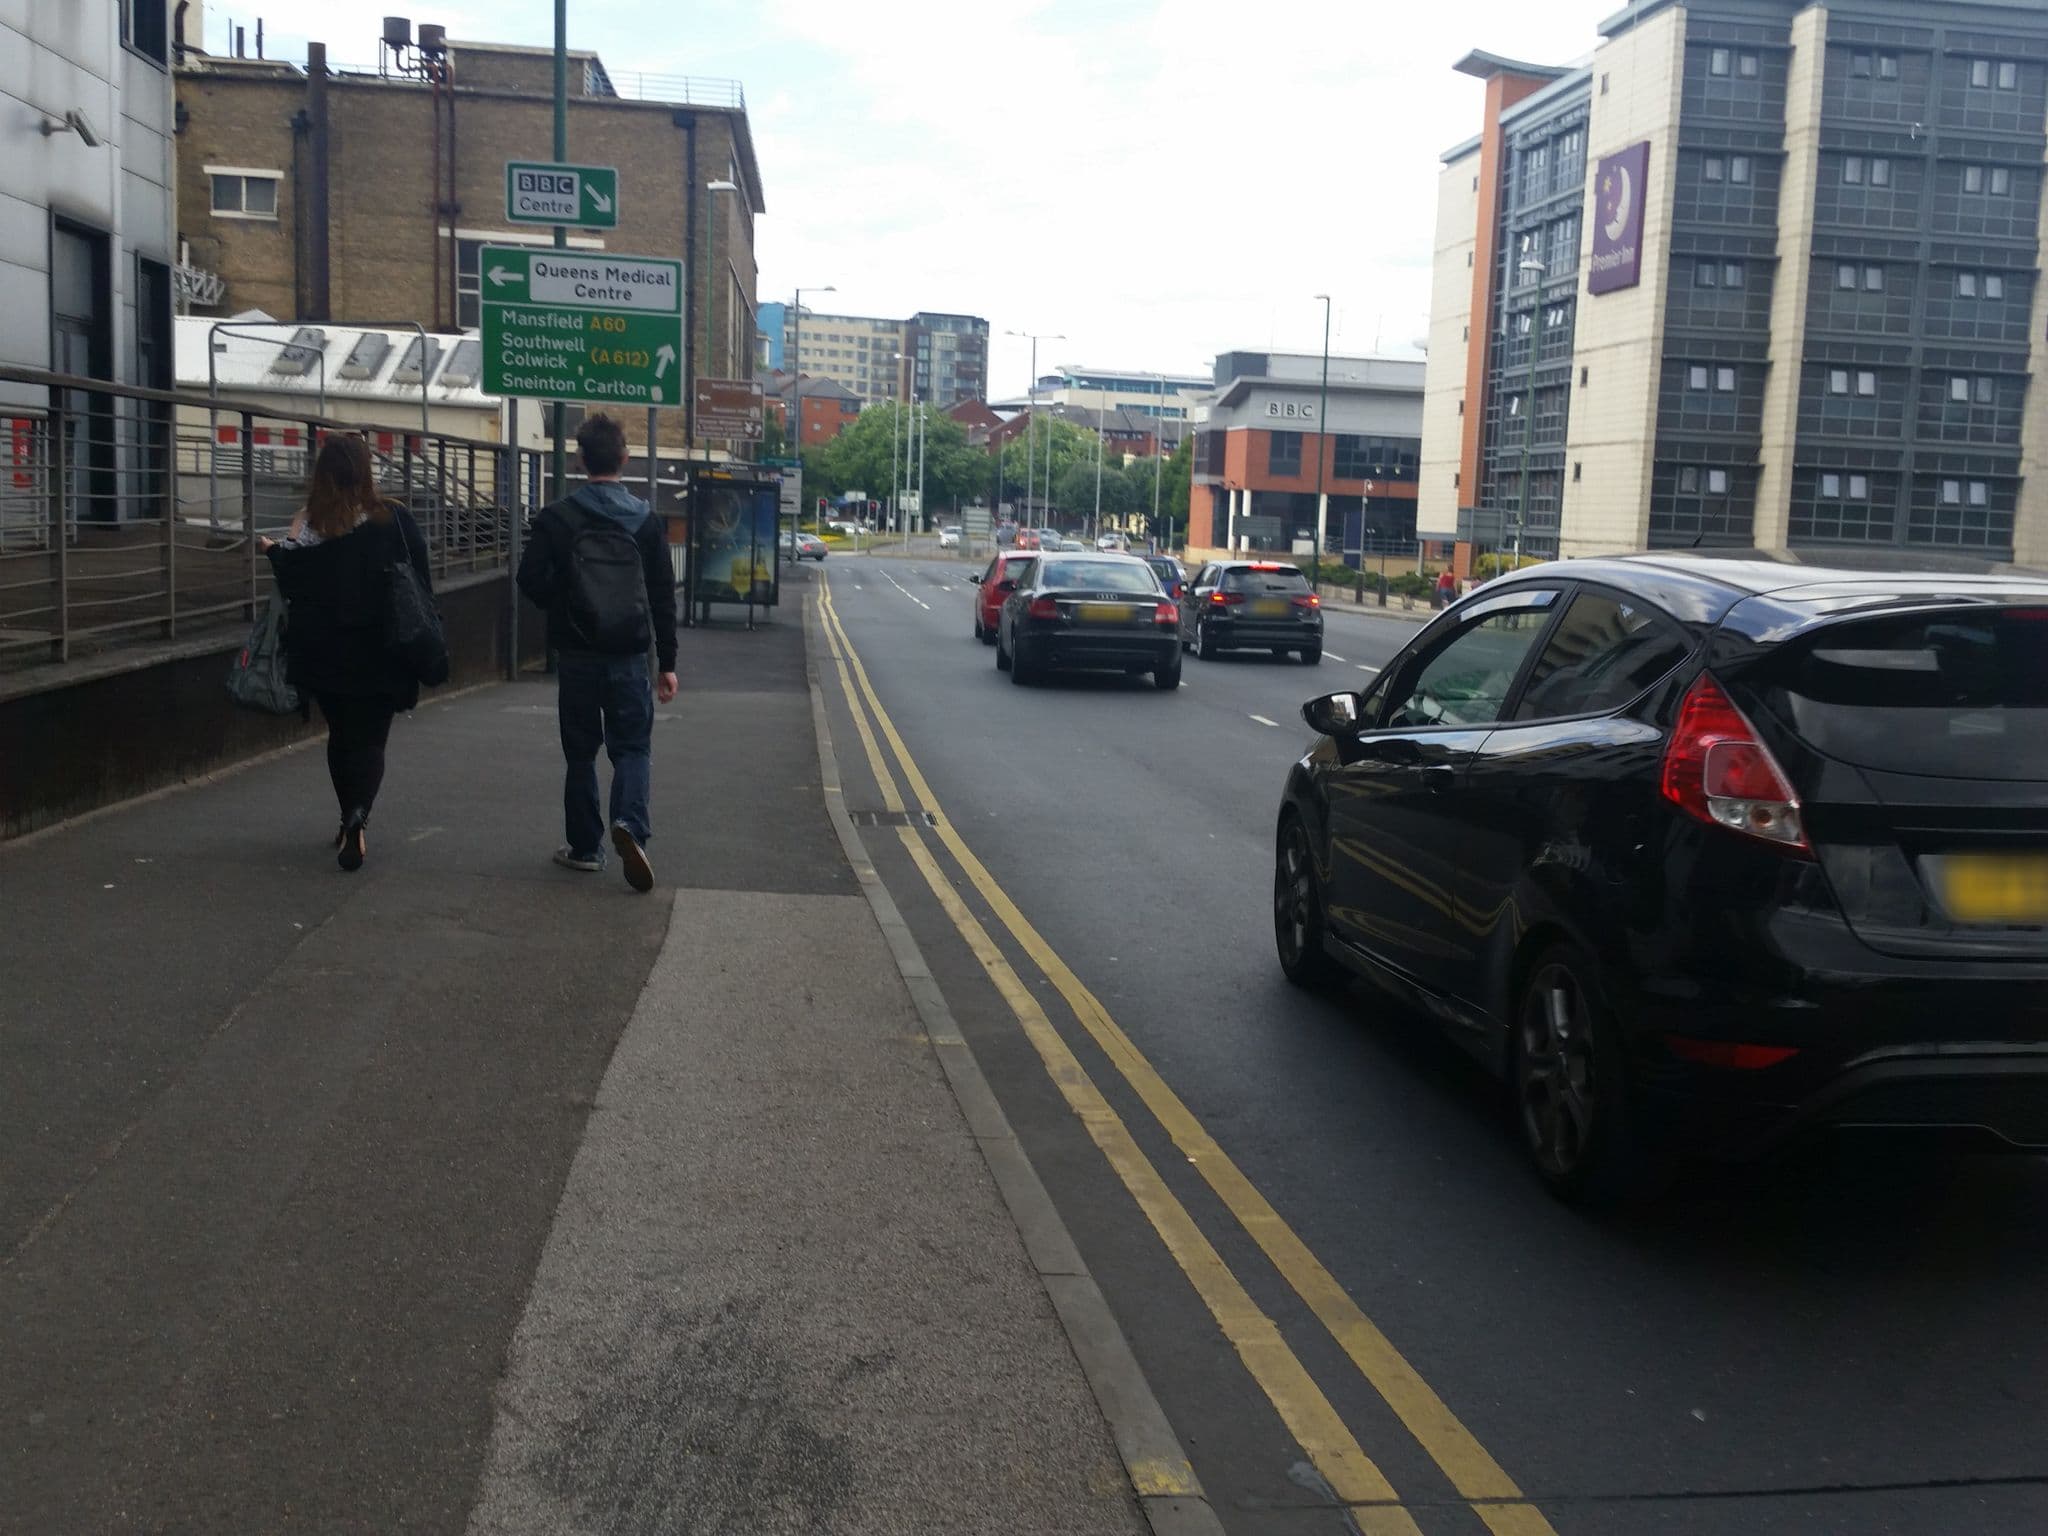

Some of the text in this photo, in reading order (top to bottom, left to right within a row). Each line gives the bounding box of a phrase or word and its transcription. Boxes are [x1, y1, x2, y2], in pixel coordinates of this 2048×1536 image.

[519, 174, 573, 194] BBC
[520, 197, 573, 214] Centre
[535, 262, 672, 286] Queens Medical
[574, 283, 633, 301] Centre
[502, 309, 627, 332] Mansfield A60
[502, 332, 586, 352] Southwell
[502, 350, 568, 369] Colwick
[502, 373, 647, 396] Sneinton Carlton
[1268, 402, 1313, 417] BBC
